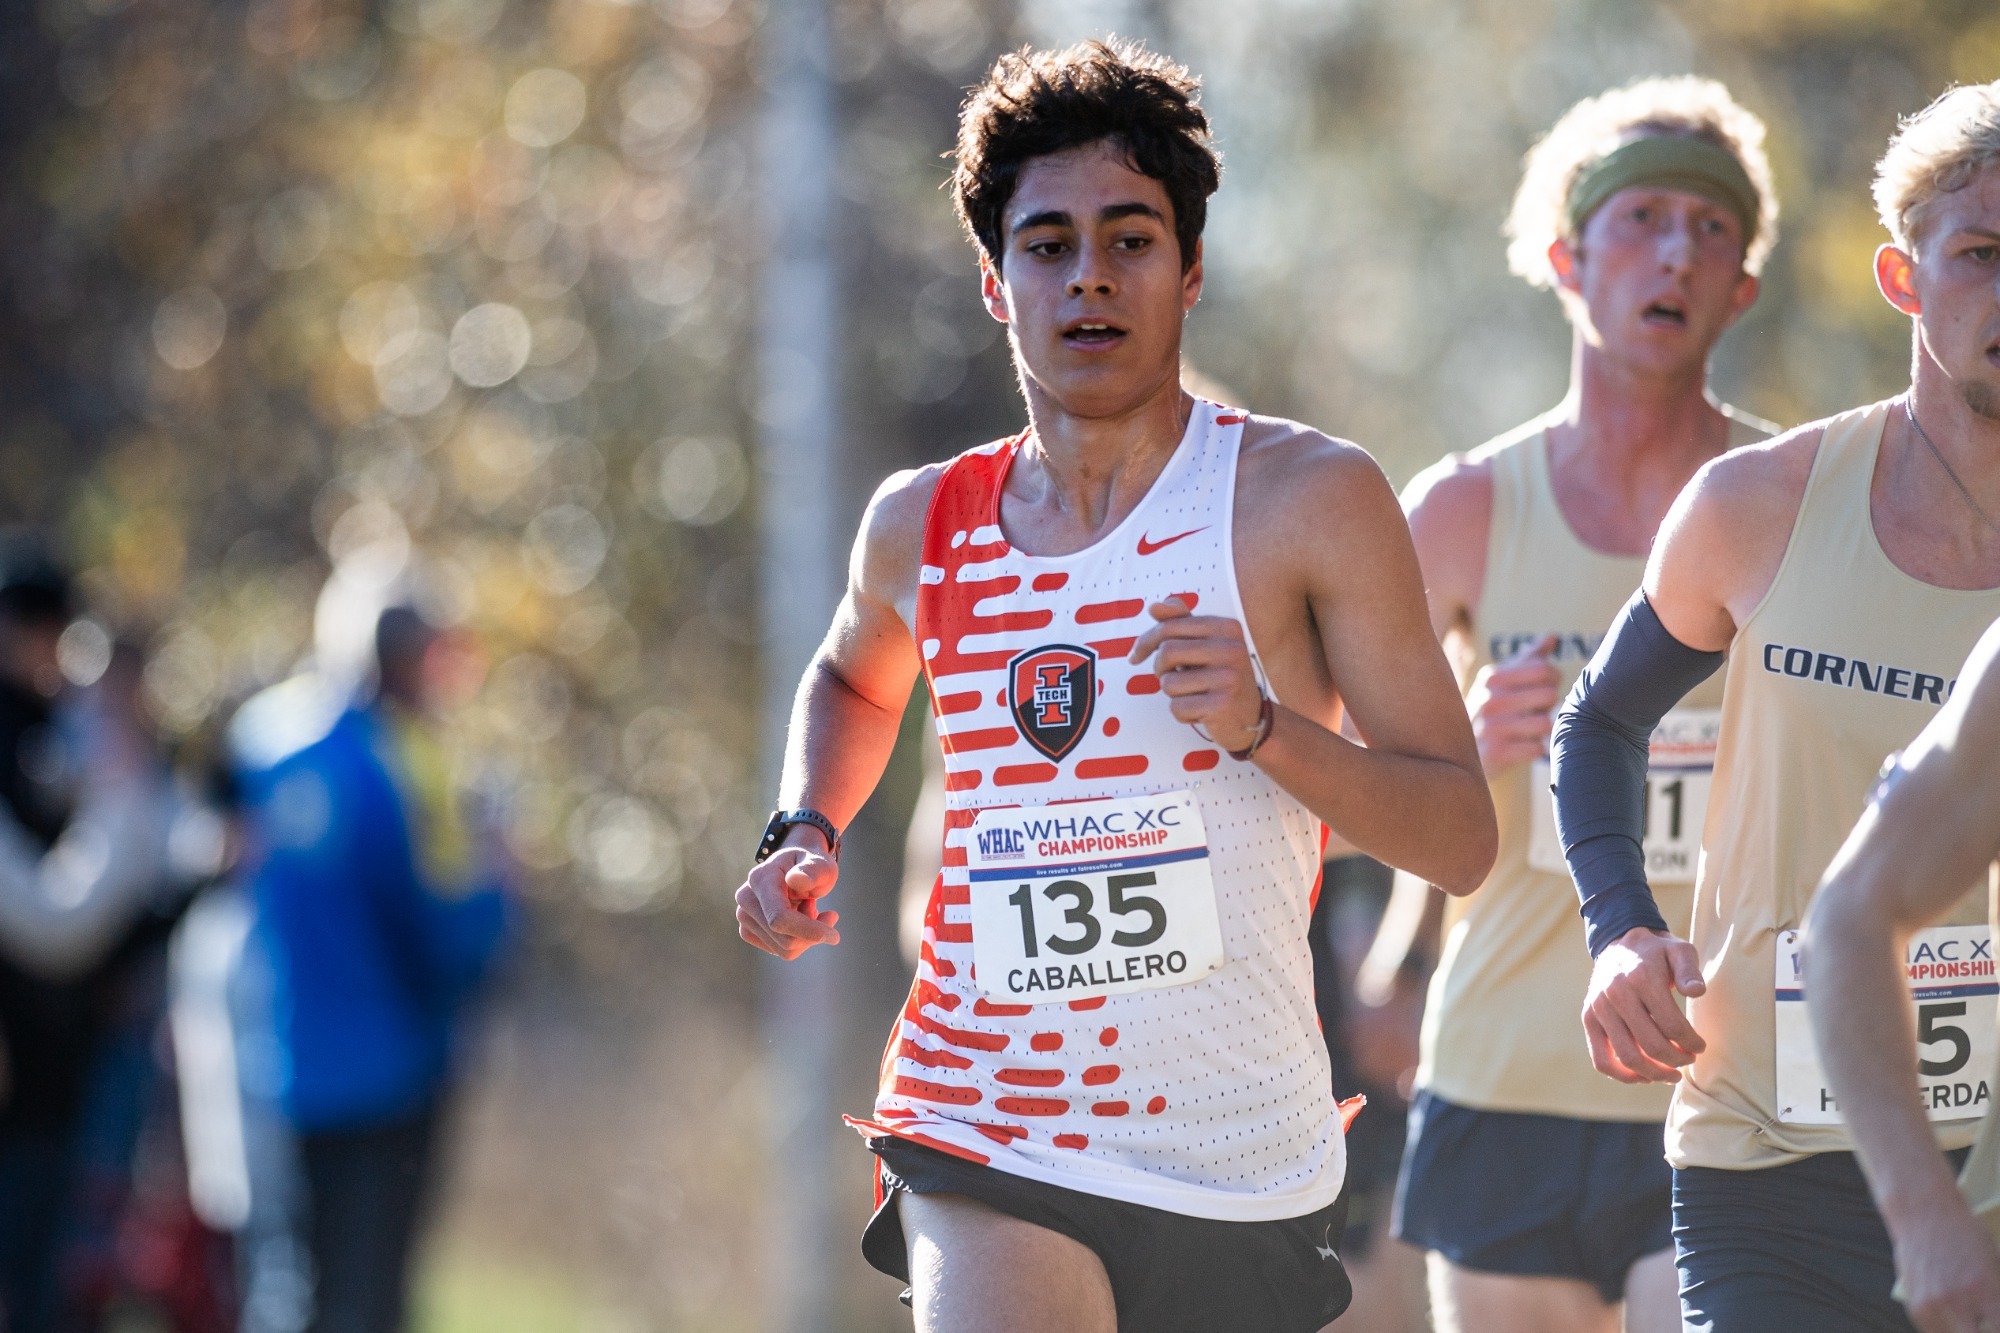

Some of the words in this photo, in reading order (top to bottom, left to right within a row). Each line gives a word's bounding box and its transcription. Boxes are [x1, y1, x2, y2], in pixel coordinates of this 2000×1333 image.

[1763, 643, 1957, 705] CORNER
[1038, 689, 1067, 701] TECH
[1023, 814, 1126, 841] WHAC
[1134, 805, 1181, 831] XC
[977, 828, 1024, 855] WHAC
[1038, 829, 1168, 857] CHAMPIONSHIP
[1048, 867, 1069, 875] results
[1008, 871, 1167, 958] 135
[1008, 950, 1187, 994] CABALLERO
